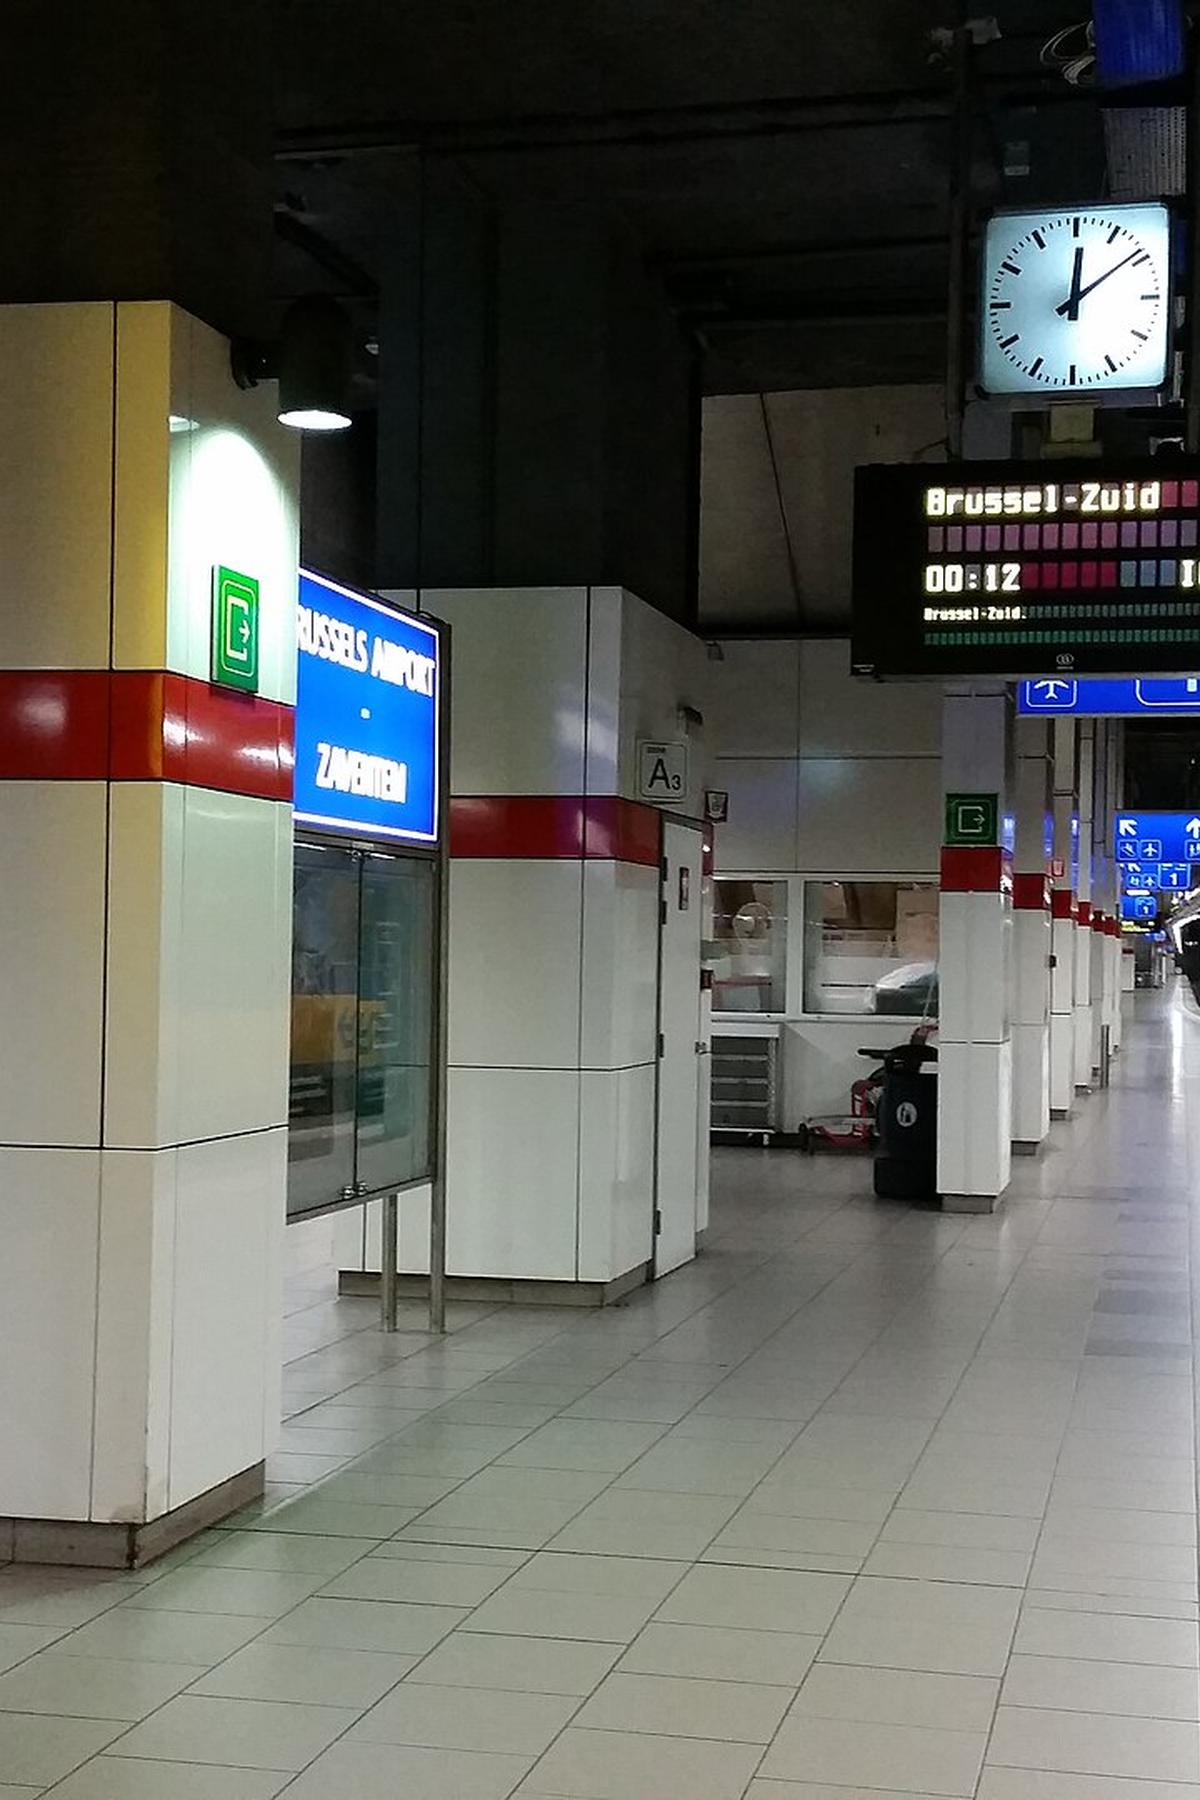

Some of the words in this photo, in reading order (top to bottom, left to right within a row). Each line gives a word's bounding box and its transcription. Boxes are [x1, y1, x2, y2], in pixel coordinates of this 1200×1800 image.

[927, 482, 1160, 515] Brussel-Zuid
[925, 563, 1021, 593] 00:12
[1181, 559, 1200, 588] I
[370, 635, 437, 697] AIRPORT
